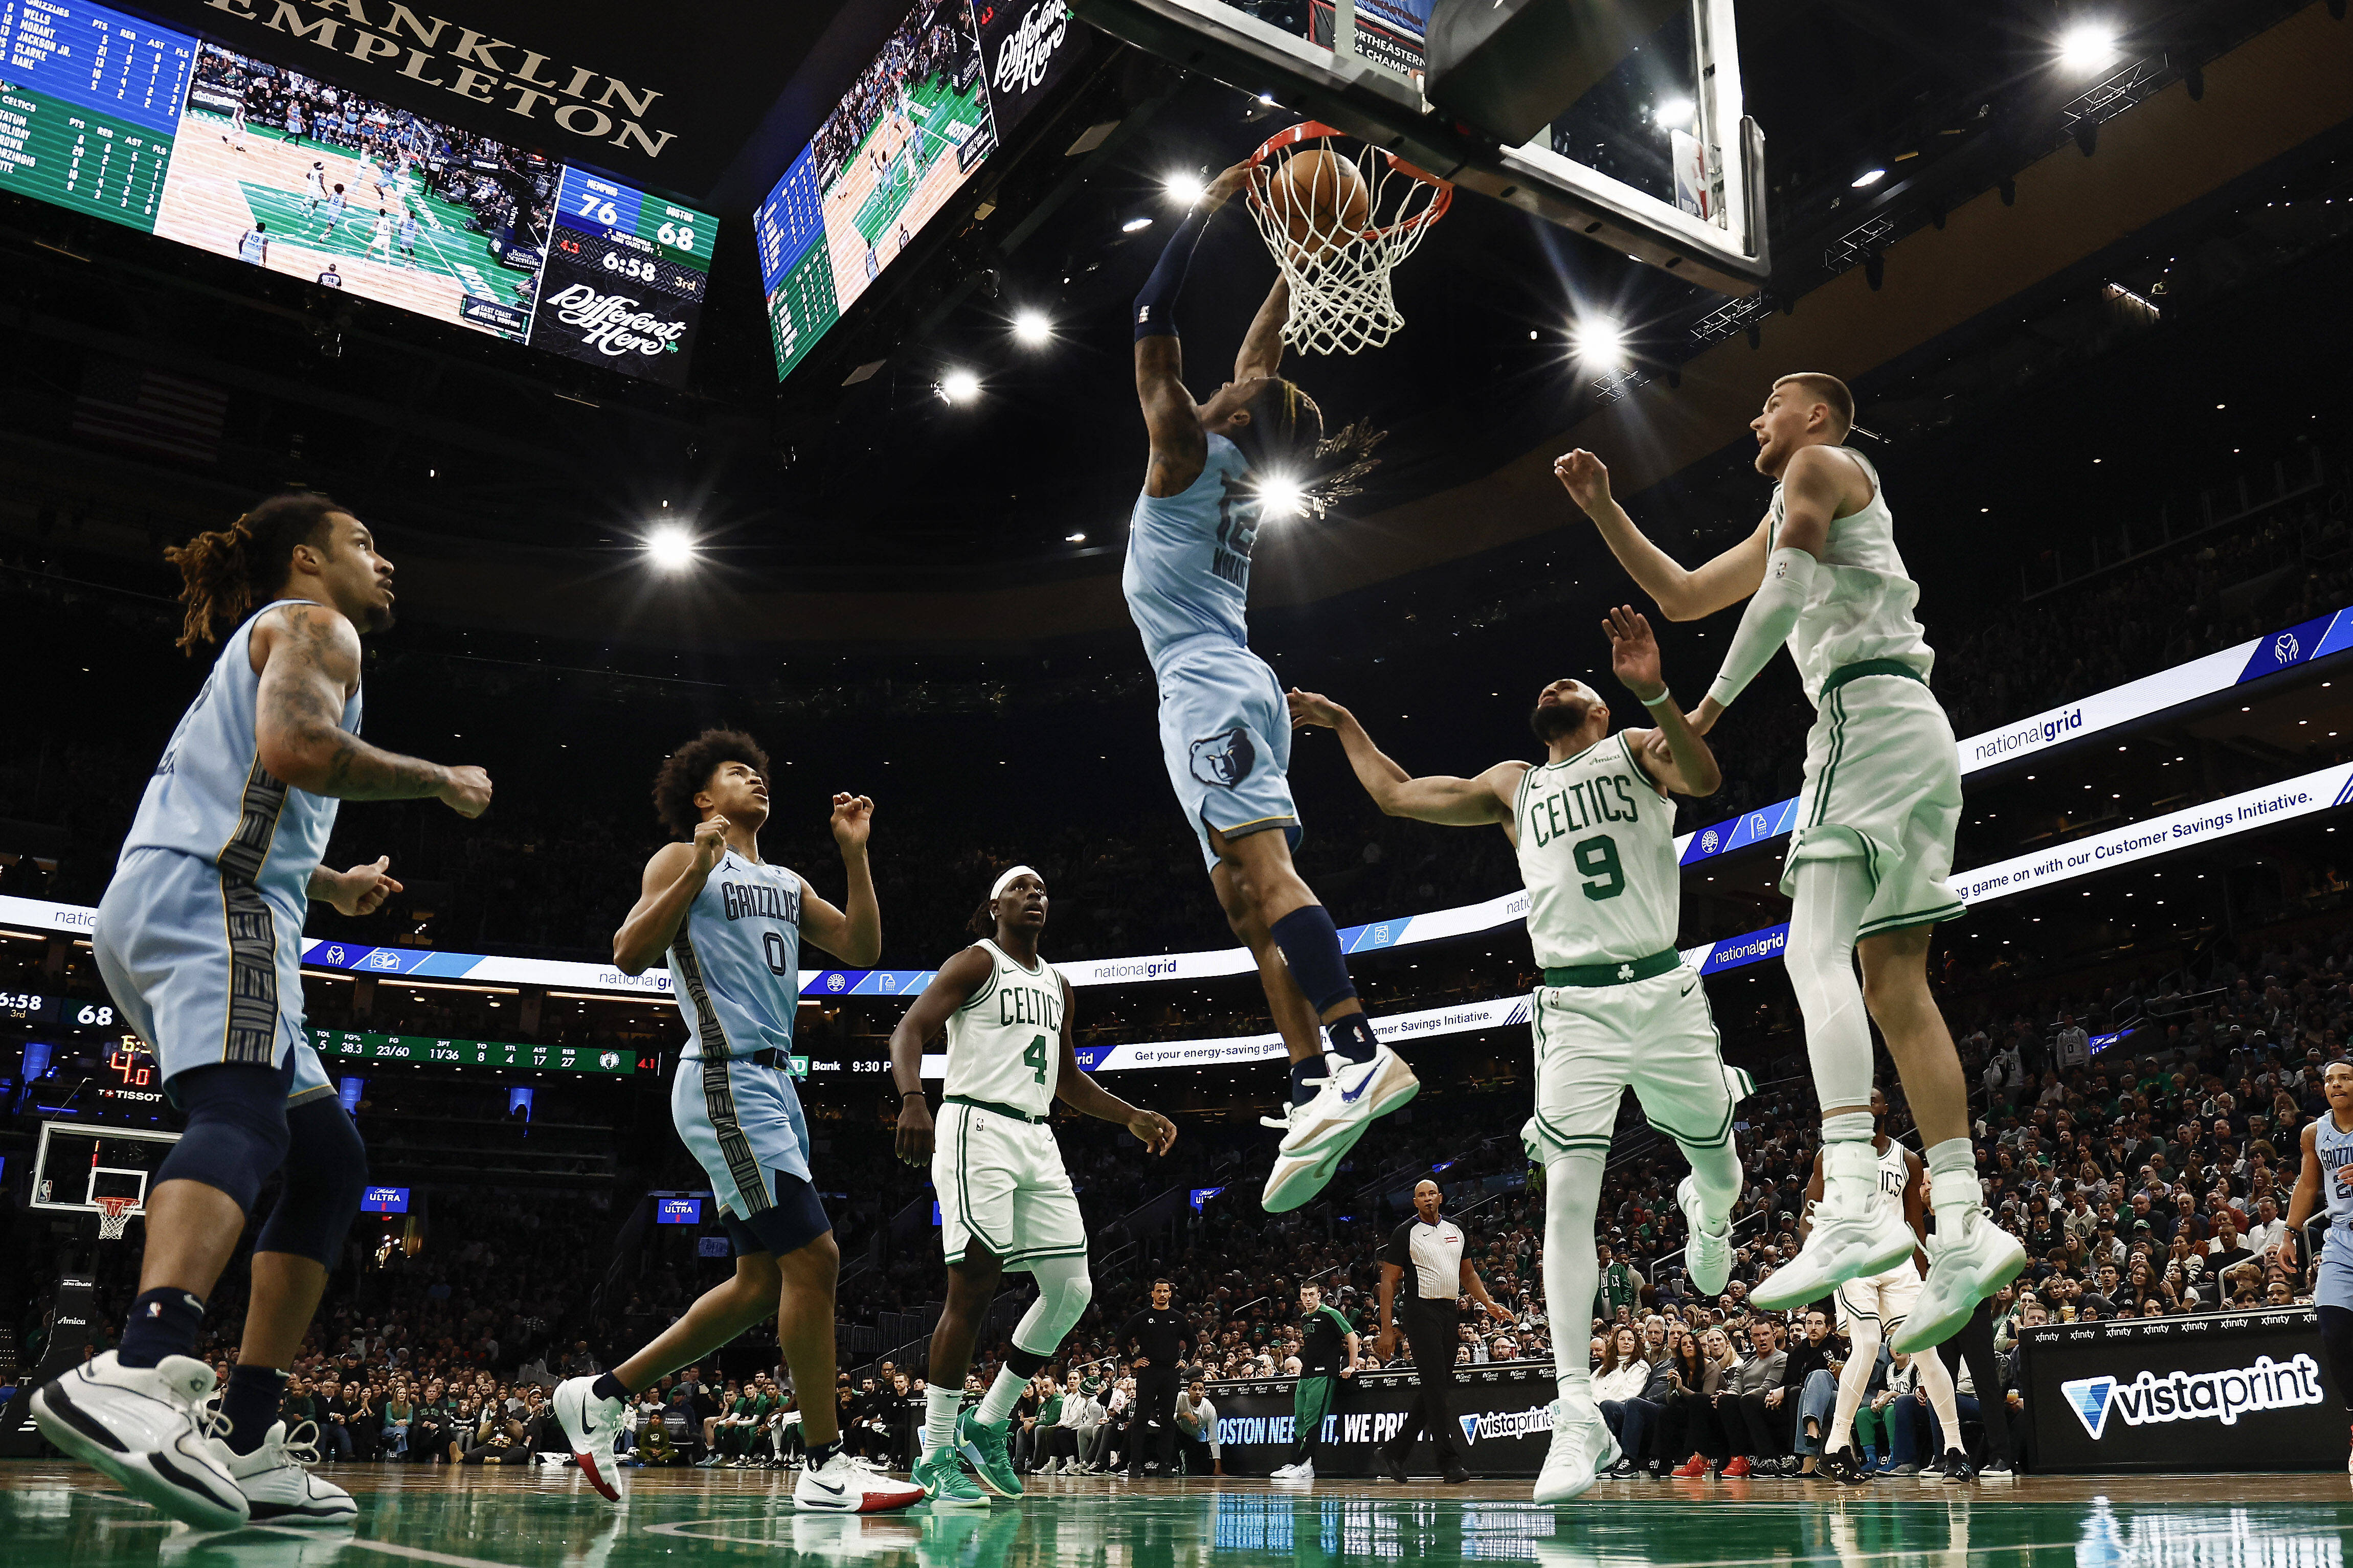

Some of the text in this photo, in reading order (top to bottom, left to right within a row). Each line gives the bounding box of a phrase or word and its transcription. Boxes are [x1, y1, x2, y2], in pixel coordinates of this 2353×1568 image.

[3, 13, 13, 25] 12
[19, 19, 56, 39] MORANT
[97, 45, 108, 56] 21
[177, 72, 183, 82] 1
[23, 7, 51, 26] WELLS
[101, 34, 109, 45] 5
[129, 43, 135, 54] 1
[178, 60, 186, 71] 2
[92, 19, 189, 58] PTS REB AST FLS
[1, 25, 180, 94] 13 JACKSON JR. 13 7 1 2
[1002, 13, 1066, 94] Here
[11, 54, 175, 116] BANE 5 2 2 2
[14, 42, 178, 104] CLARKE 16 4 2 3
[2, 95, 36, 112] CELTICS
[69, 117, 167, 155] PTS REB AST FLS
[0, 134, 156, 192] ROWN 1 4 1
[72, 145, 159, 180] 20 2 1 1
[131, 151, 138, 162] 5
[155, 159, 162, 169] 2
[94, 189, 128, 208] 3 3
[98, 177, 104, 188] 4
[123, 186, 130, 196] 2
[147, 193, 154, 203] 3
[578, 193, 695, 251] 76 68
[666, 206, 694, 222] BOSTON
[512, 248, 534, 260] Boston
[560, 239, 580, 254] 4.3
[625, 239, 641, 249] OUTS
[641, 245, 655, 254] LEFT
[506, 253, 541, 267] Scientific
[602, 252, 656, 282] 6:58
[675, 276, 696, 291] 3rd
[479, 311, 521, 328] METAL ROOFING
[480, 305, 512, 320] EAST COAST
[546, 283, 687, 340] Different
[558, 310, 665, 356] Here
[1976, 709, 2082, 760] nationalgrid
[1531, 775, 1638, 848] CELTICS
[1973, 876, 2009, 896] game
[2013, 869, 2030, 882] on
[2034, 861, 2063, 876] with
[2067, 852, 2091, 868] our
[2094, 830, 2168, 859] Customer
[2171, 812, 2233, 838] Savings
[2237, 789, 2313, 821] Initiative.
[1573, 835, 1625, 901] 9
[722, 882, 799, 926] GRIZZLIE
[763, 932, 786, 977] 0
[1716, 933, 1784, 965] nationalgrid
[599, 970, 673, 990] nationalgr
[1094, 959, 1177, 978] nationalgrid
[10, 1010, 26, 1018] 3rd
[78, 1006, 113, 1026] 68
[1000, 987, 1063, 1035] CELTICS
[1401, 1010, 1493, 1033] Savings Initiative.
[319, 1040, 575, 1067] 5 38.3 23/60 11/36 8 4 17 27
[638, 1058, 655, 1069] 4.1
[812, 1060, 880, 1072] Bank 9:30
[1023, 1034, 1047, 1085] 4
[1135, 1044, 1260, 1062] Get your energy-saving
[110, 1052, 150, 1085] 4.0
[116, 1090, 162, 1102] TISSOT
[57, 1316, 86, 1325] Amica
[2106, 1327, 2132, 1337] xfinity
[2143, 1324, 2169, 1335] xfinity
[2181, 1321, 2208, 1332] xfinity
[2221, 1318, 2248, 1329] xfinity
[2261, 1315, 2290, 1326] xfinity
[2035, 1332, 2059, 1342] xfinity
[2070, 1329, 2095, 1340] xfinity
[2119, 1361, 2317, 1418] vistaprint
[1218, 1414, 1374, 1445] OSTON NEE WE
[1481, 1407, 1551, 1436] vistaprint
